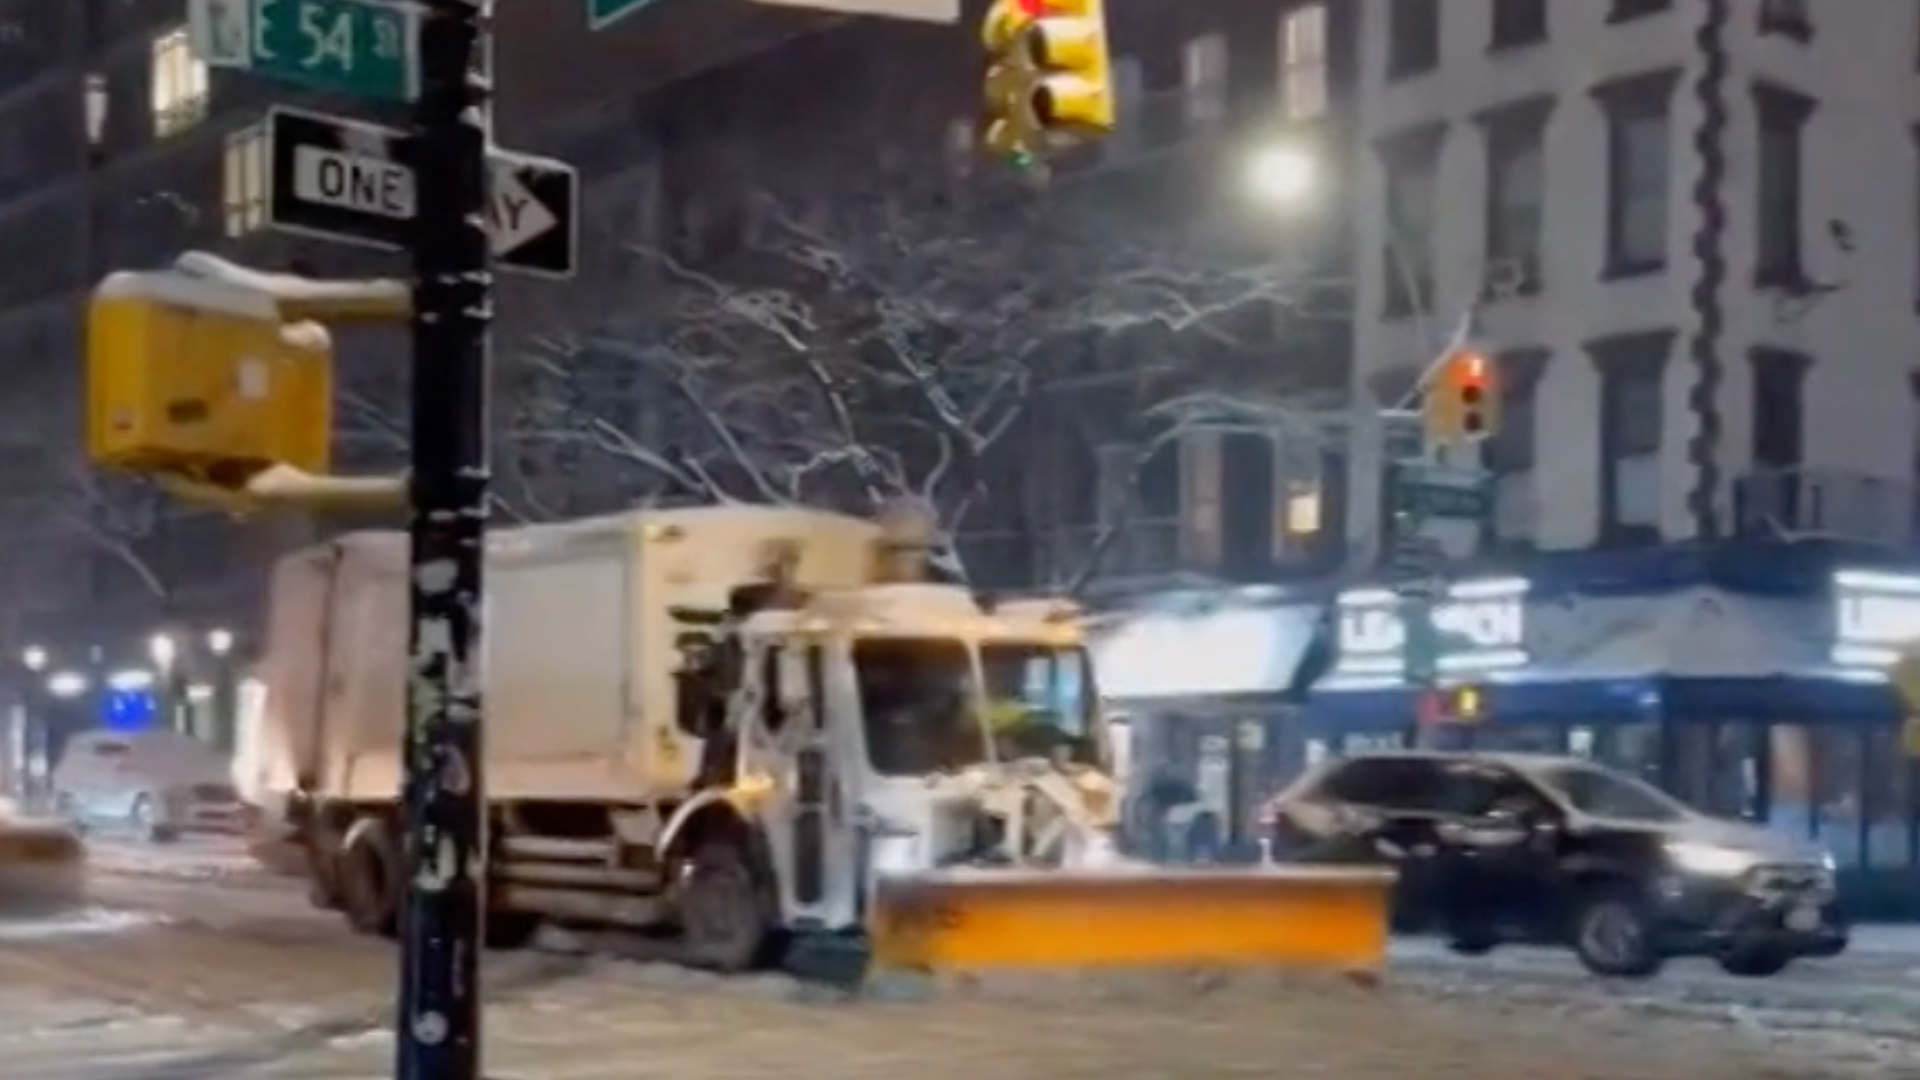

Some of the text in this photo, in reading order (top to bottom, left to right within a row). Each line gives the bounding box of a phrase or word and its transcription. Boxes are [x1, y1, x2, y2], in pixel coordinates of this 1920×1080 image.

[254, 0, 278, 60] E
[301, 5, 353, 71] 54
[319, 157, 404, 212] ONE
